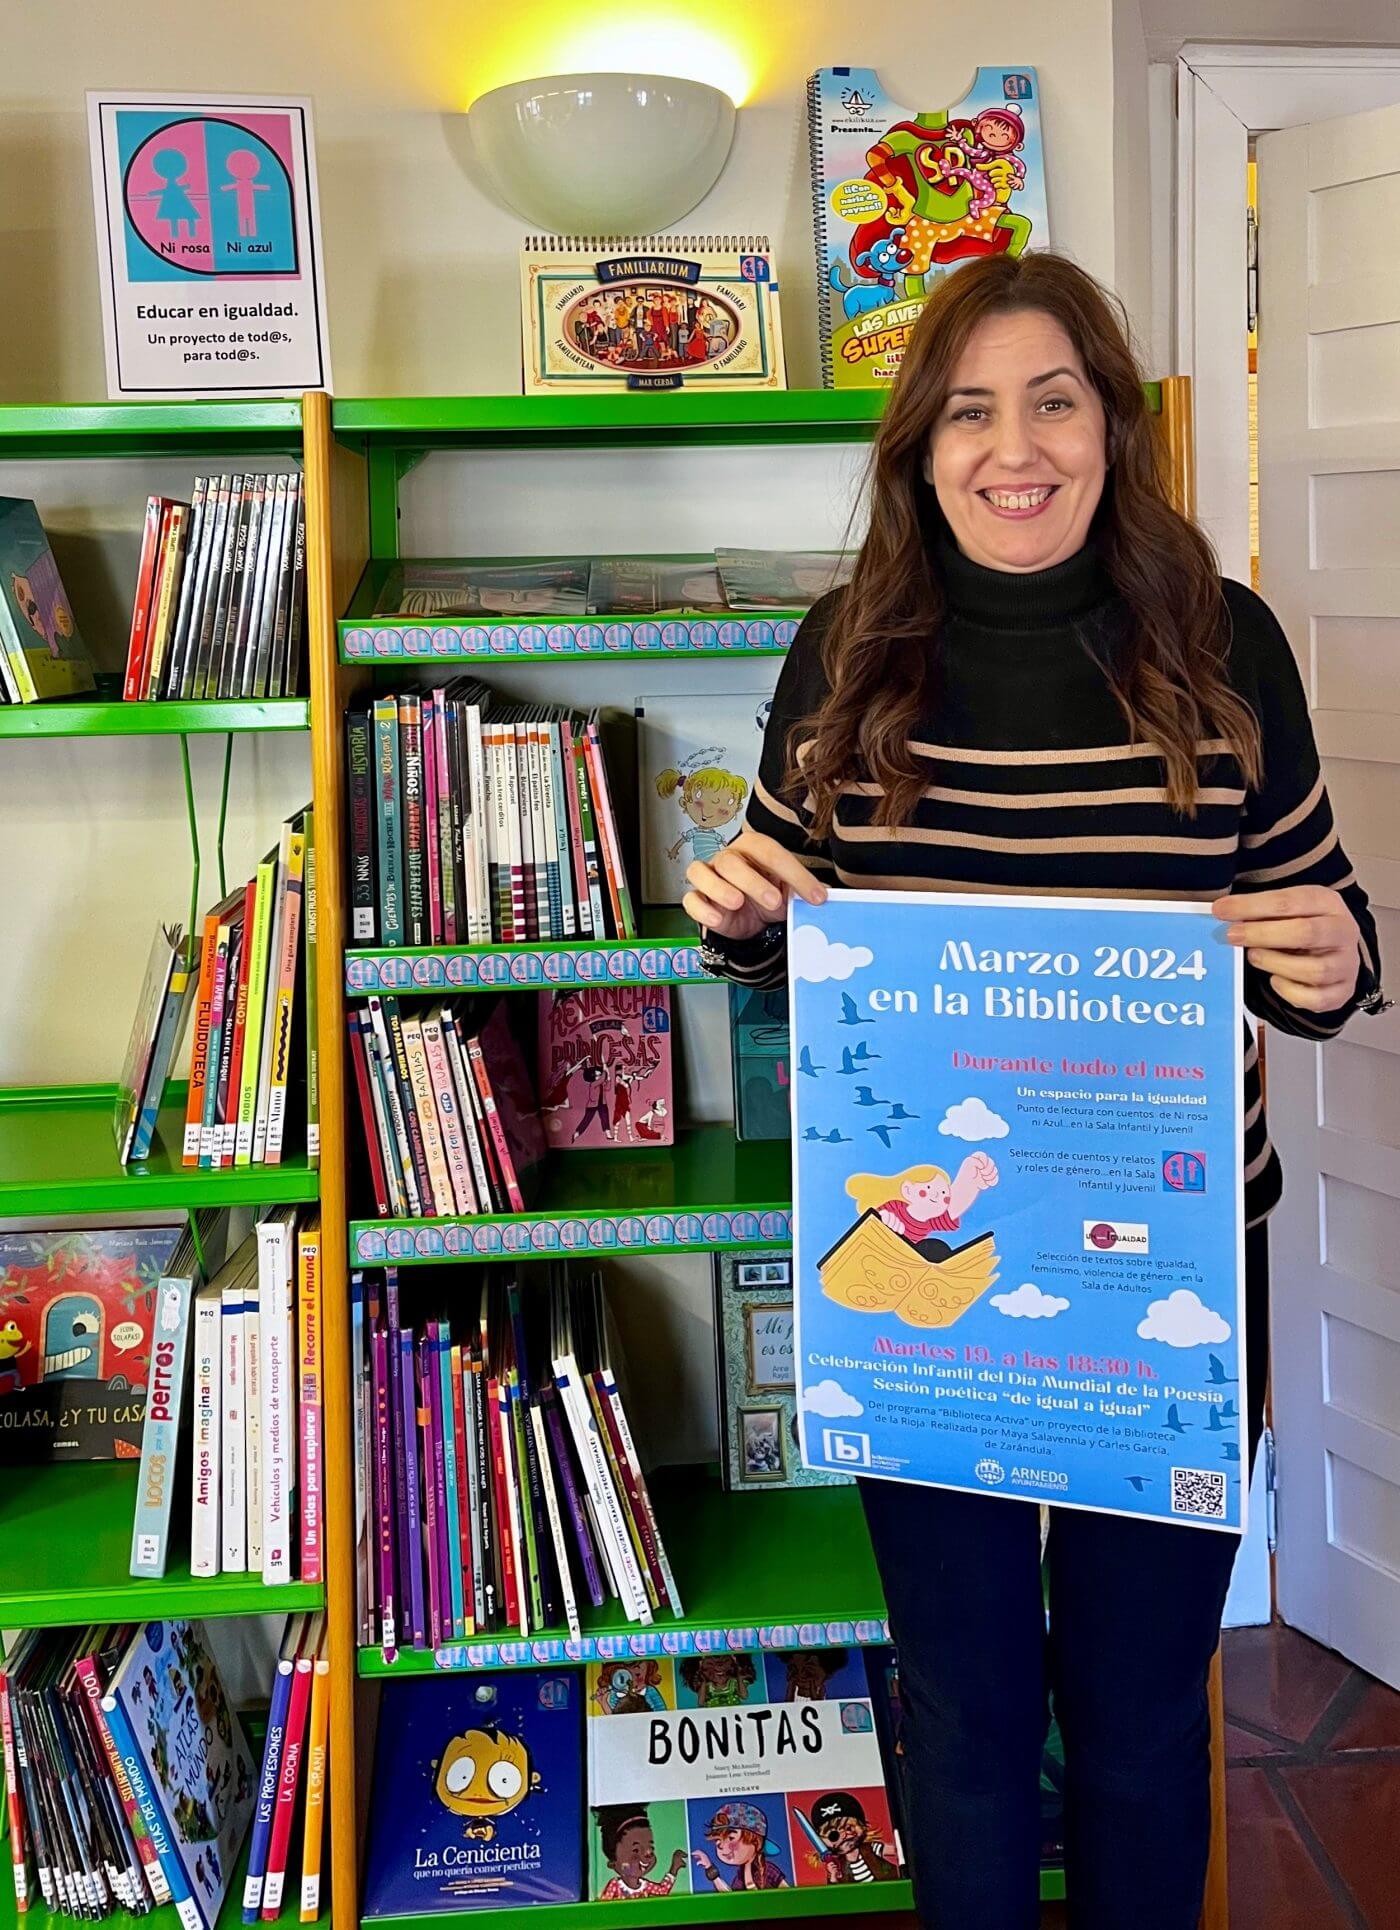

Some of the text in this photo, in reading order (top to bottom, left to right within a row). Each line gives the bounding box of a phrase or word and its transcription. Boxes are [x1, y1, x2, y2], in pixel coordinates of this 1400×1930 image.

[161, 242, 210, 253] Ni rosa
[227, 242, 272, 253] Ni azul
[608, 263, 689, 278] FAMILIARIUM
[556, 285, 584, 311] FAMILIARIO
[716, 285, 746, 311] FAMILIARI
[137, 303, 298, 320] Educar en igualdad.
[148, 331, 292, 346] Un proyecto de tod@s,
[853, 315, 883, 337] LAS
[184, 349, 259, 363] para tod@s.
[404, 756, 421, 794] NIÑOS
[483, 775, 493, 800] Pinocho
[507, 775, 516, 804] Rapunzel
[519, 776, 528, 816] Blancanieves
[531, 780, 539, 799] patito
[543, 784, 552, 808] Sirenita
[497, 802, 505, 827] cerditos
[286, 912, 296, 942] completa
[284, 959, 292, 972] Una
[940, 941, 1207, 981] Marzo 2024
[235, 983, 248, 1024] CONTAR
[869, 984, 1205, 1027] en la Biblioteca
[425, 1026, 438, 1034] PEQ
[189, 1000, 213, 1089] FLUIDOTECA
[219, 1017, 232, 1081] SOLA EN EL BOSQUE
[952, 1050, 1205, 1080] Durante todo el mes
[270, 1090, 282, 1122] Mano
[1017, 1087, 1207, 1105] Un espacio para la igualdad
[1018, 1104, 1044, 1114] Punto
[1047, 1106, 1059, 1114] de
[1062, 1106, 1094, 1115] lectura
[1117, 1110, 1154, 1118] cuentos
[1160, 1111, 1172, 1119] de
[1174, 1111, 1184, 1119] Ni
[1187, 1113, 1208, 1121] rosa
[1010, 1149, 1156, 1165] Selección de cuentos y relatos
[1079, 1181, 1155, 1192] Infantil y Juvenil
[1037, 1252, 1197, 1270] Selección de textos sobre igualdad,
[1082, 1281, 1152, 1293] Sala de Adultos
[302, 1298, 315, 1309] el
[304, 1319, 316, 1366] Recorre
[271, 1335, 283, 1400] transporte
[873, 1336, 956, 1361] Martes
[1003, 1354, 1015, 1366] a
[1024, 1350, 1058, 1371] las
[1068, 1354, 1130, 1375] 18:30
[1138, 1360, 1158, 1379] h.
[151, 1341, 175, 1423] perros
[808, 1353, 1223, 1403] Celebración Infantil del Día Mundial de la Poesía
[873, 1378, 929, 1395] Sesión
[935, 1386, 997, 1402] poética
[1036, 1394, 1078, 1410] igual
[1083, 1403, 1094, 1412] a
[270, 1403, 280, 1416] de
[196, 1357, 211, 1506] Amigos imaginarios
[271, 1417, 280, 1452] medios
[272, 1454, 283, 1465] y
[985, 1441, 1055, 1456] de Zarándula.
[304, 1409, 319, 1545] Un atlas para explorar
[1011, 1466, 1068, 1484] ARNEDO
[1011, 1478, 1068, 1491] AYUNTAMIENTO
[83, 1671, 100, 1698] 100
[176, 1710, 199, 1764] ATLAS
[184, 1725, 214, 1796] MUNDO
[279, 1740, 302, 1802] LA COCINA
[108, 1749, 135, 1802] ALIMENTOS
[123, 1754, 148, 1797] MUNDO
[257, 1725, 284, 1823] LAS PROFESIONES
[309, 1743, 324, 1805] LA GRANJA
[139, 1798, 156, 1821] DEL
[147, 1821, 170, 1855] ATLAS
[415, 1842, 541, 1868] La Cenicienta
[413, 1861, 541, 1880] que no quería comer perdices
